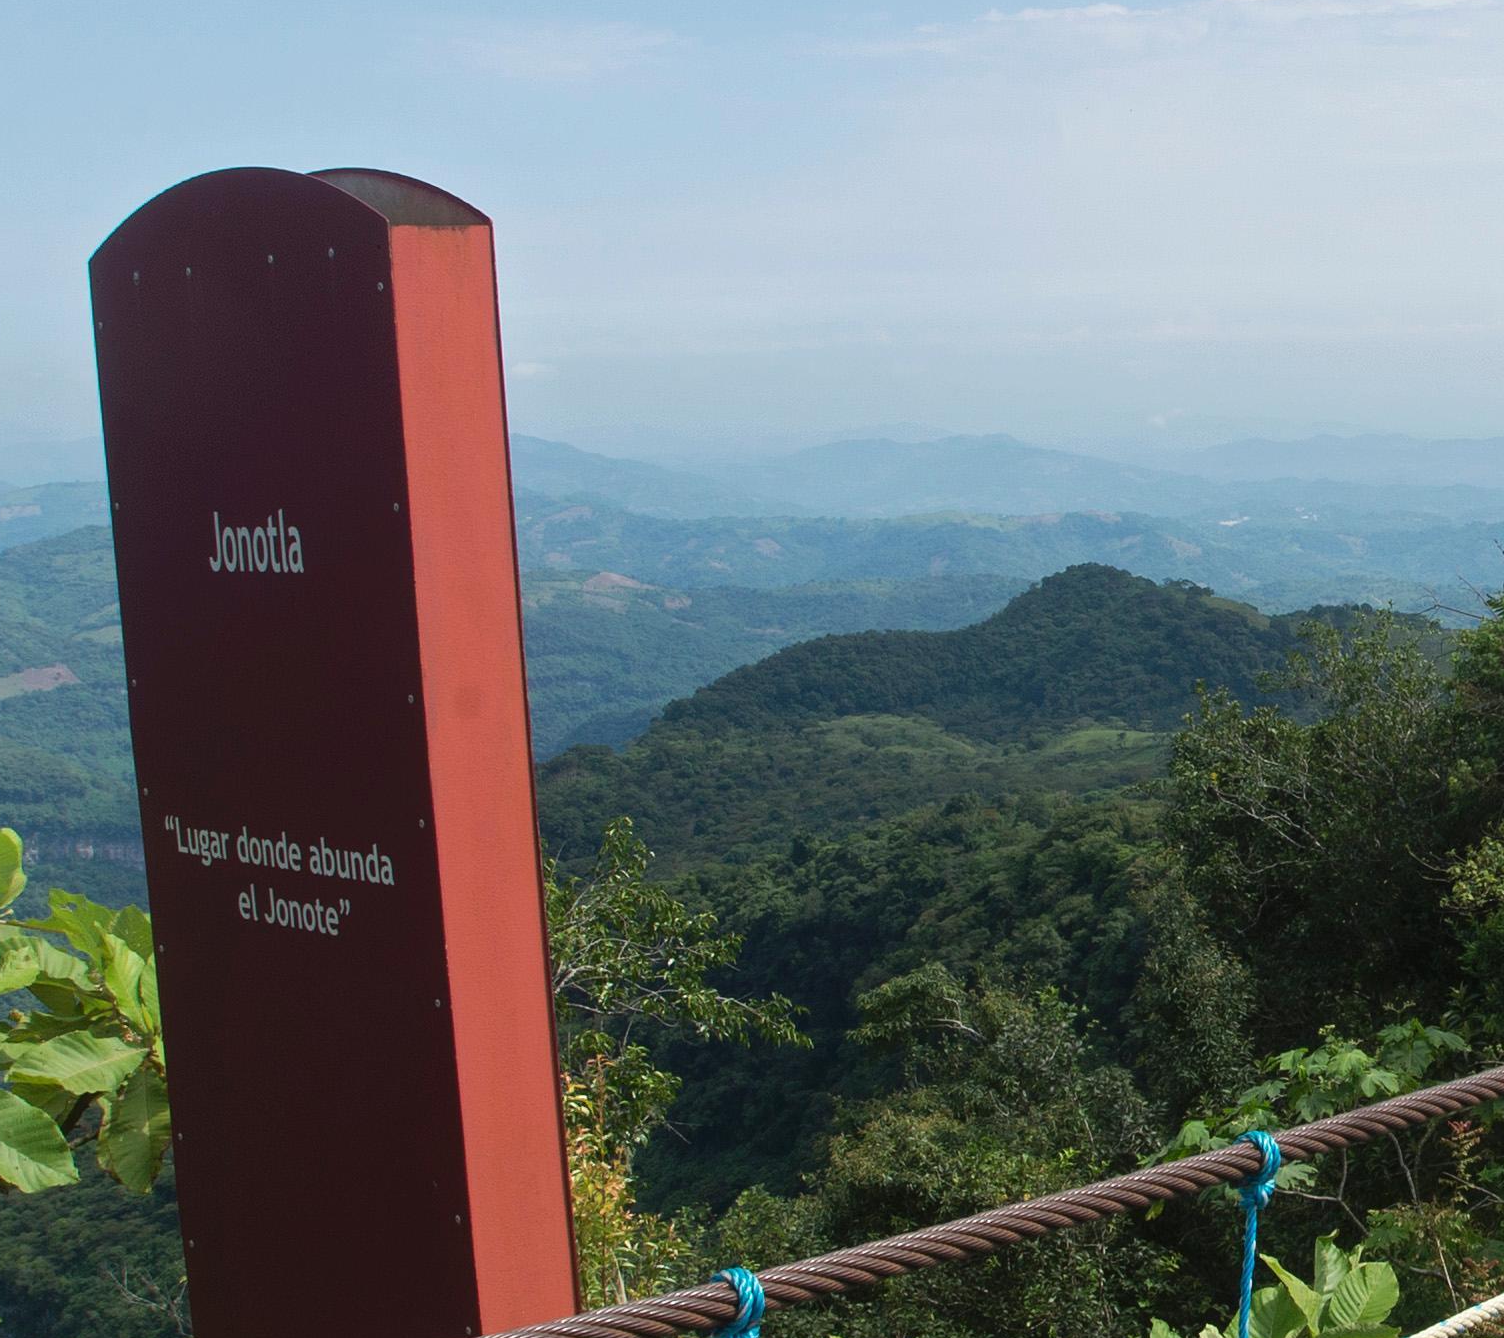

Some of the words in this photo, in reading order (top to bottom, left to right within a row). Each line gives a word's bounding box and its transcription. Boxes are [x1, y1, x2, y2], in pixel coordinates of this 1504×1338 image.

[209, 508, 304, 574] Jonotla
[165, 815, 229, 867] “Lugar
[236, 826, 302, 872] donde
[309, 837, 395, 886] abunda
[238, 883, 259, 921] el
[264, 887, 351, 936] Jonote”
